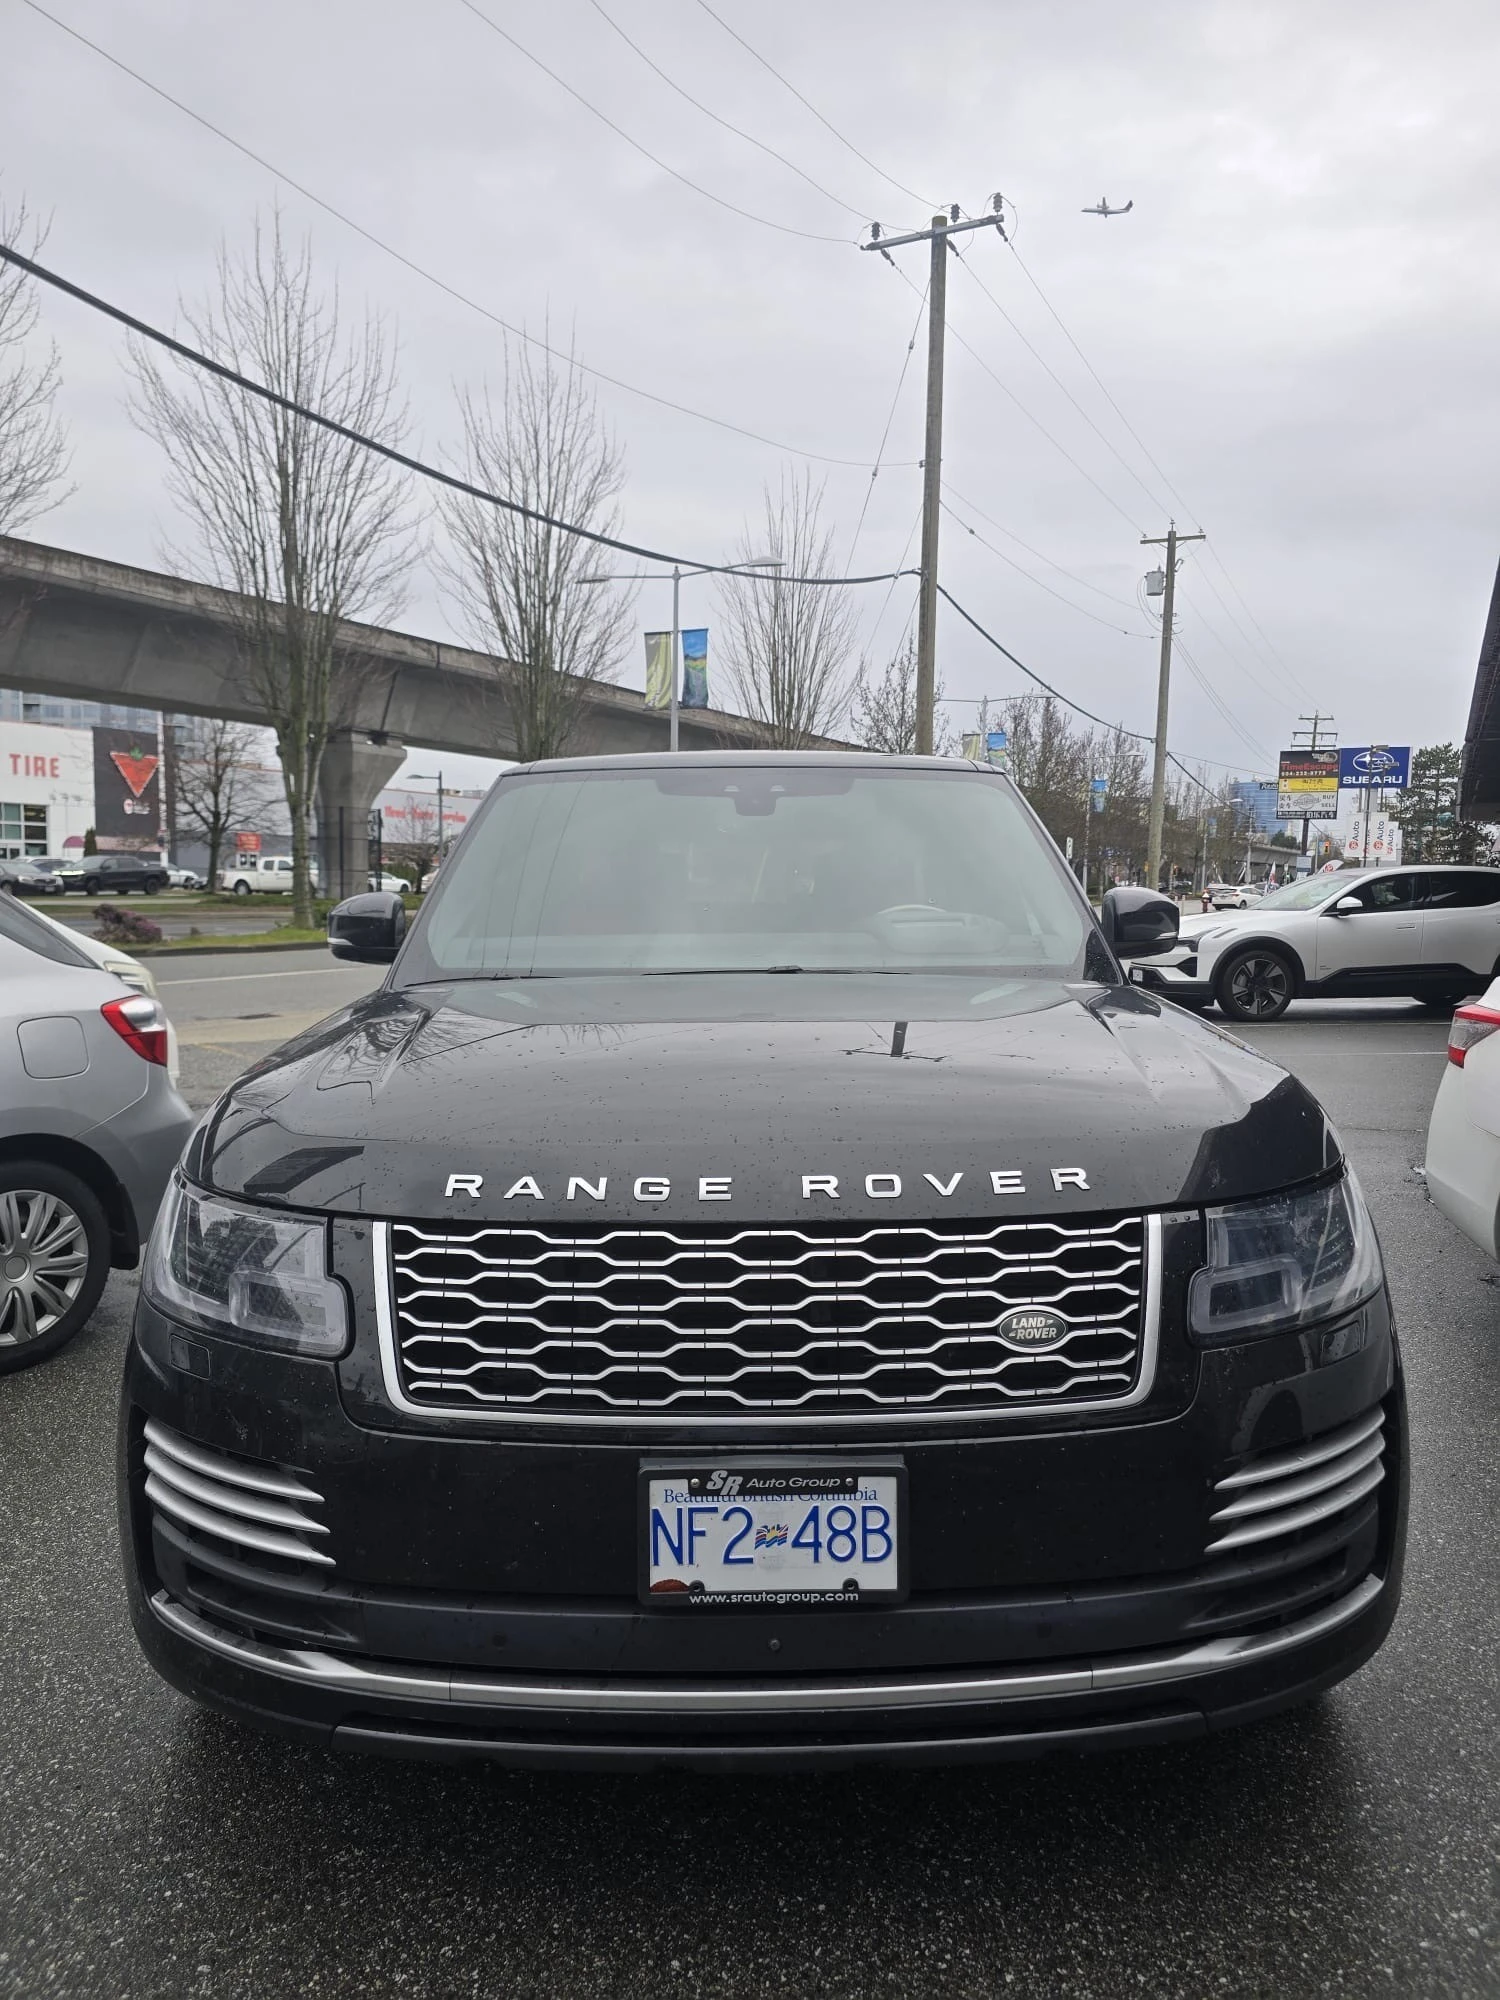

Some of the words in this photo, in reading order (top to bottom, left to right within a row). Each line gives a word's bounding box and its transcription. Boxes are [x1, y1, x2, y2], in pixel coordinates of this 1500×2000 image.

[9, 753, 61, 778] TIRE
[1342, 775, 1403, 784] SUBARU
[1352, 821, 1360, 842] Auto
[444, 1174, 733, 1202] RANGE
[801, 1167, 1091, 1199] ROVER
[1011, 1317, 1046, 1329] LAND
[1016, 1327, 1058, 1340] ROVER
[706, 1470, 744, 1496] SR
[746, 1478, 787, 1488] Auto
[788, 1477, 841, 1488] Group
[652, 1505, 755, 1567] NF2
[791, 1504, 894, 1564] 48B
[689, 1591, 860, 1604] www.srautogroup.com
